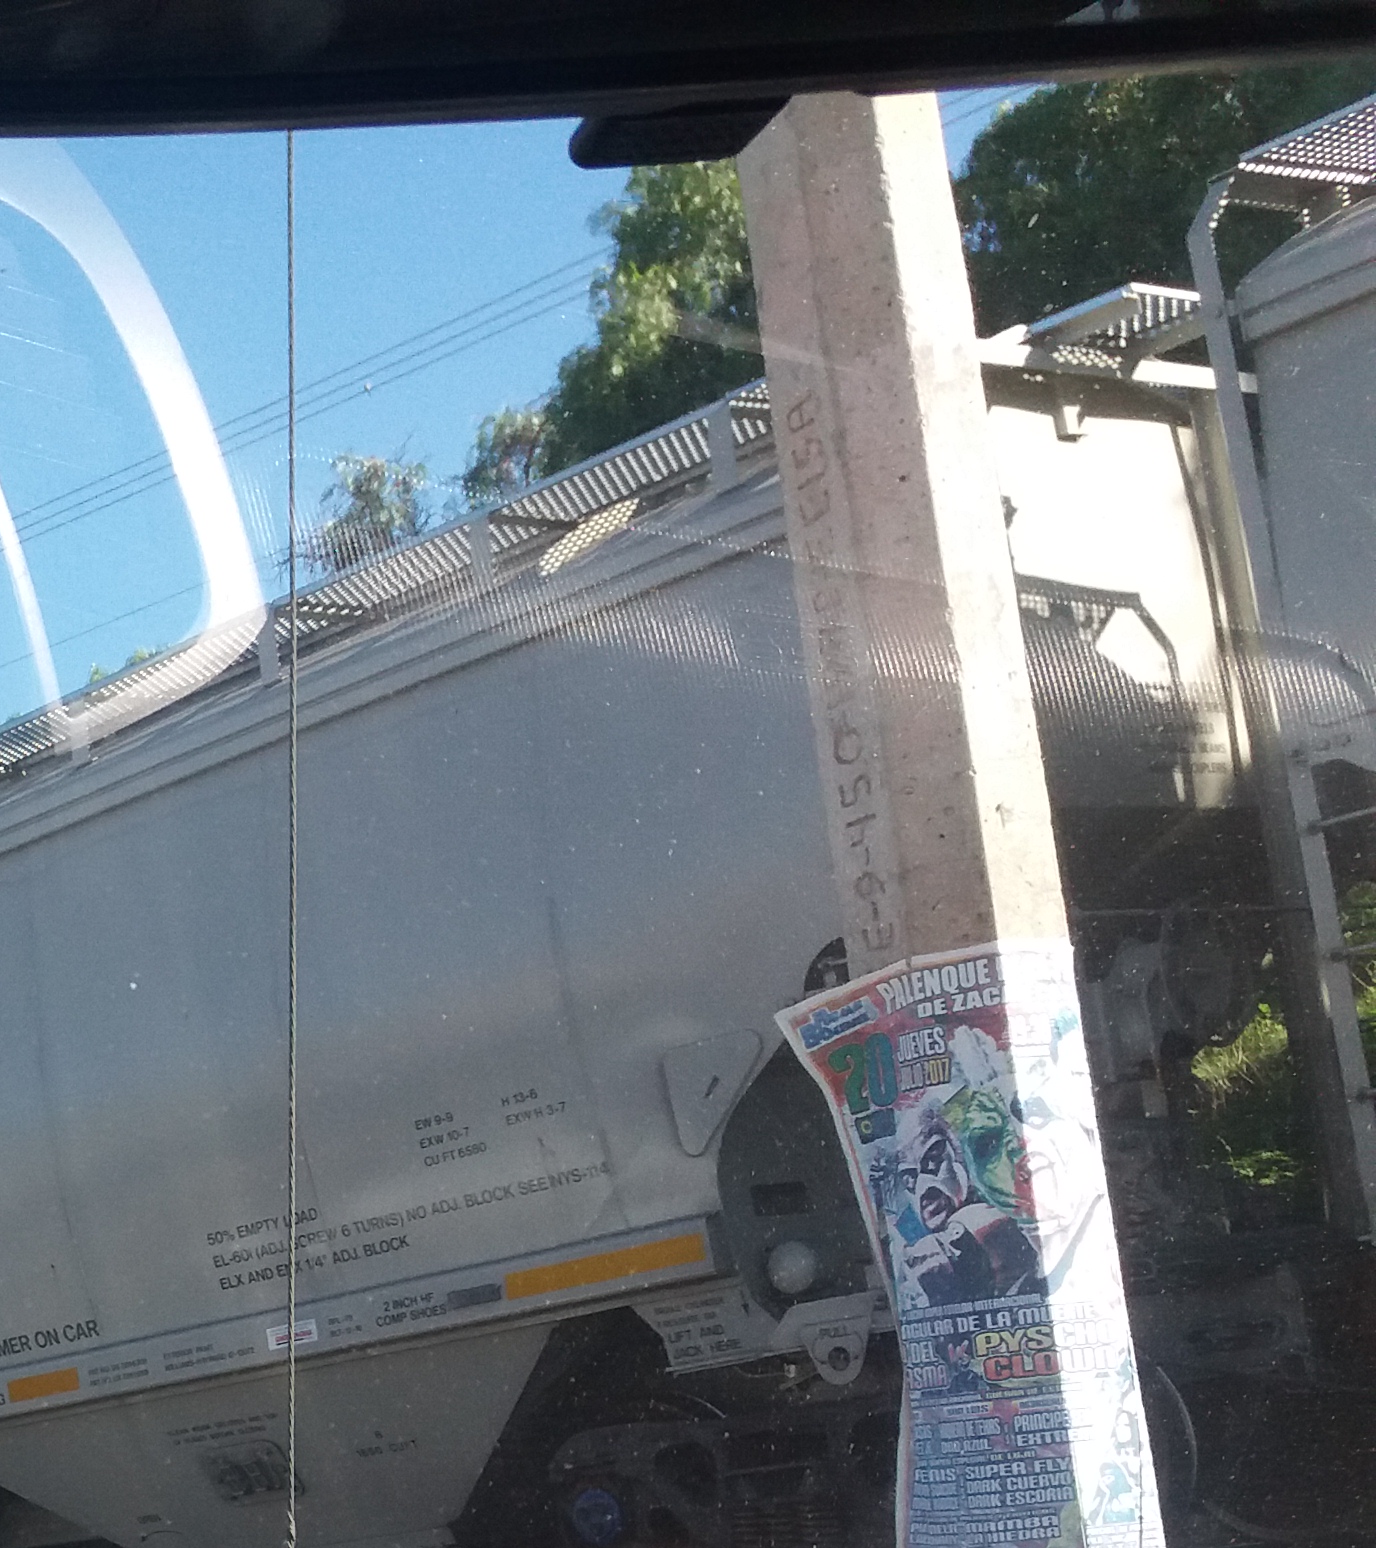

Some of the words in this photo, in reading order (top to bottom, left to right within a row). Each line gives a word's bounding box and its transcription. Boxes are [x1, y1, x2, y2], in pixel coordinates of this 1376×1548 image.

[876, 958, 989, 1015] PALENQUE
[917, 1001, 947, 1018] DE
[898, 1025, 945, 1063] JUEVES
[828, 1032, 897, 1115] 20
[342, 1223, 351, 1237] 6
[406, 1206, 427, 1222] NO
[464, 1184, 515, 1209] BLOCK
[518, 1175, 549, 1195] SEE
[236, 1216, 279, 1239] EMPTY
[219, 1274, 245, 1290] ELX
[247, 1267, 275, 1284] AND
[363, 1234, 410, 1258] BLOCK
[34, 1328, 62, 1350] ON
[63, 1319, 100, 1344] CAR
[957, 1316, 981, 1333] DE
[986, 1311, 1011, 1329] LA
[983, 1348, 1121, 1382] CLOWN
[965, 1461, 1026, 1480] SUPER
[1034, 1457, 1071, 1475] FLY
[1006, 1486, 1075, 1507] ESCORIA
[966, 1515, 1060, 1533] MAMBA
